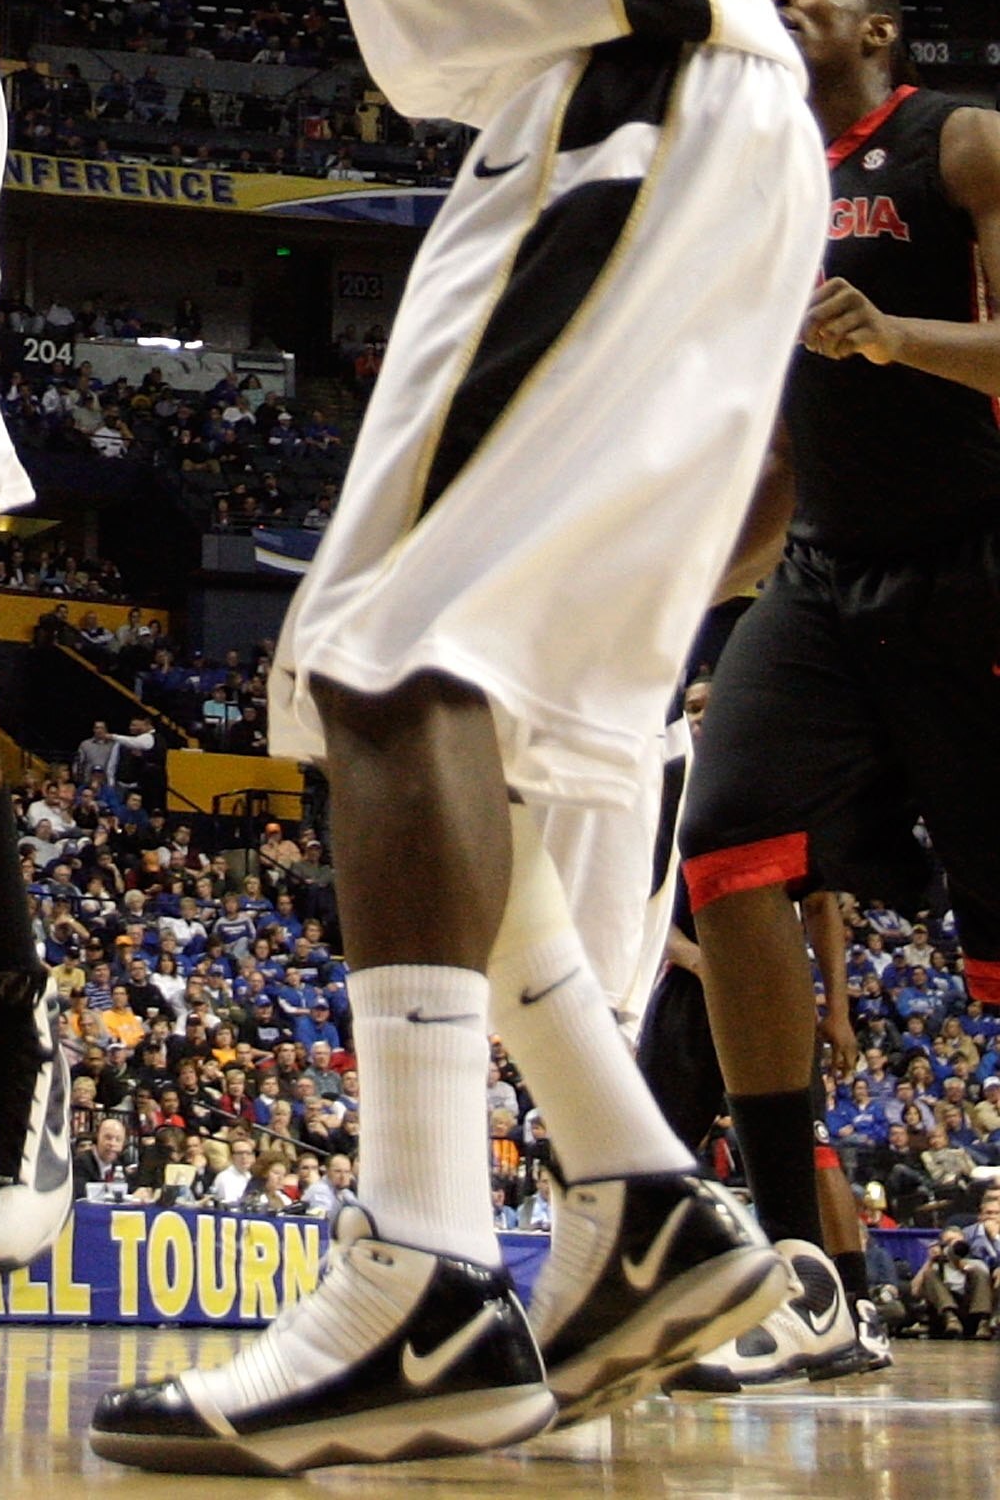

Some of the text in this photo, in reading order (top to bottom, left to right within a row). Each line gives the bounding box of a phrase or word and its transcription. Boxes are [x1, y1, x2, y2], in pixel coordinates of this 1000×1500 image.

[6, 153, 236, 203] NFERENCE
[828, 195, 912, 243] GIA
[23, 337, 74, 367] 204
